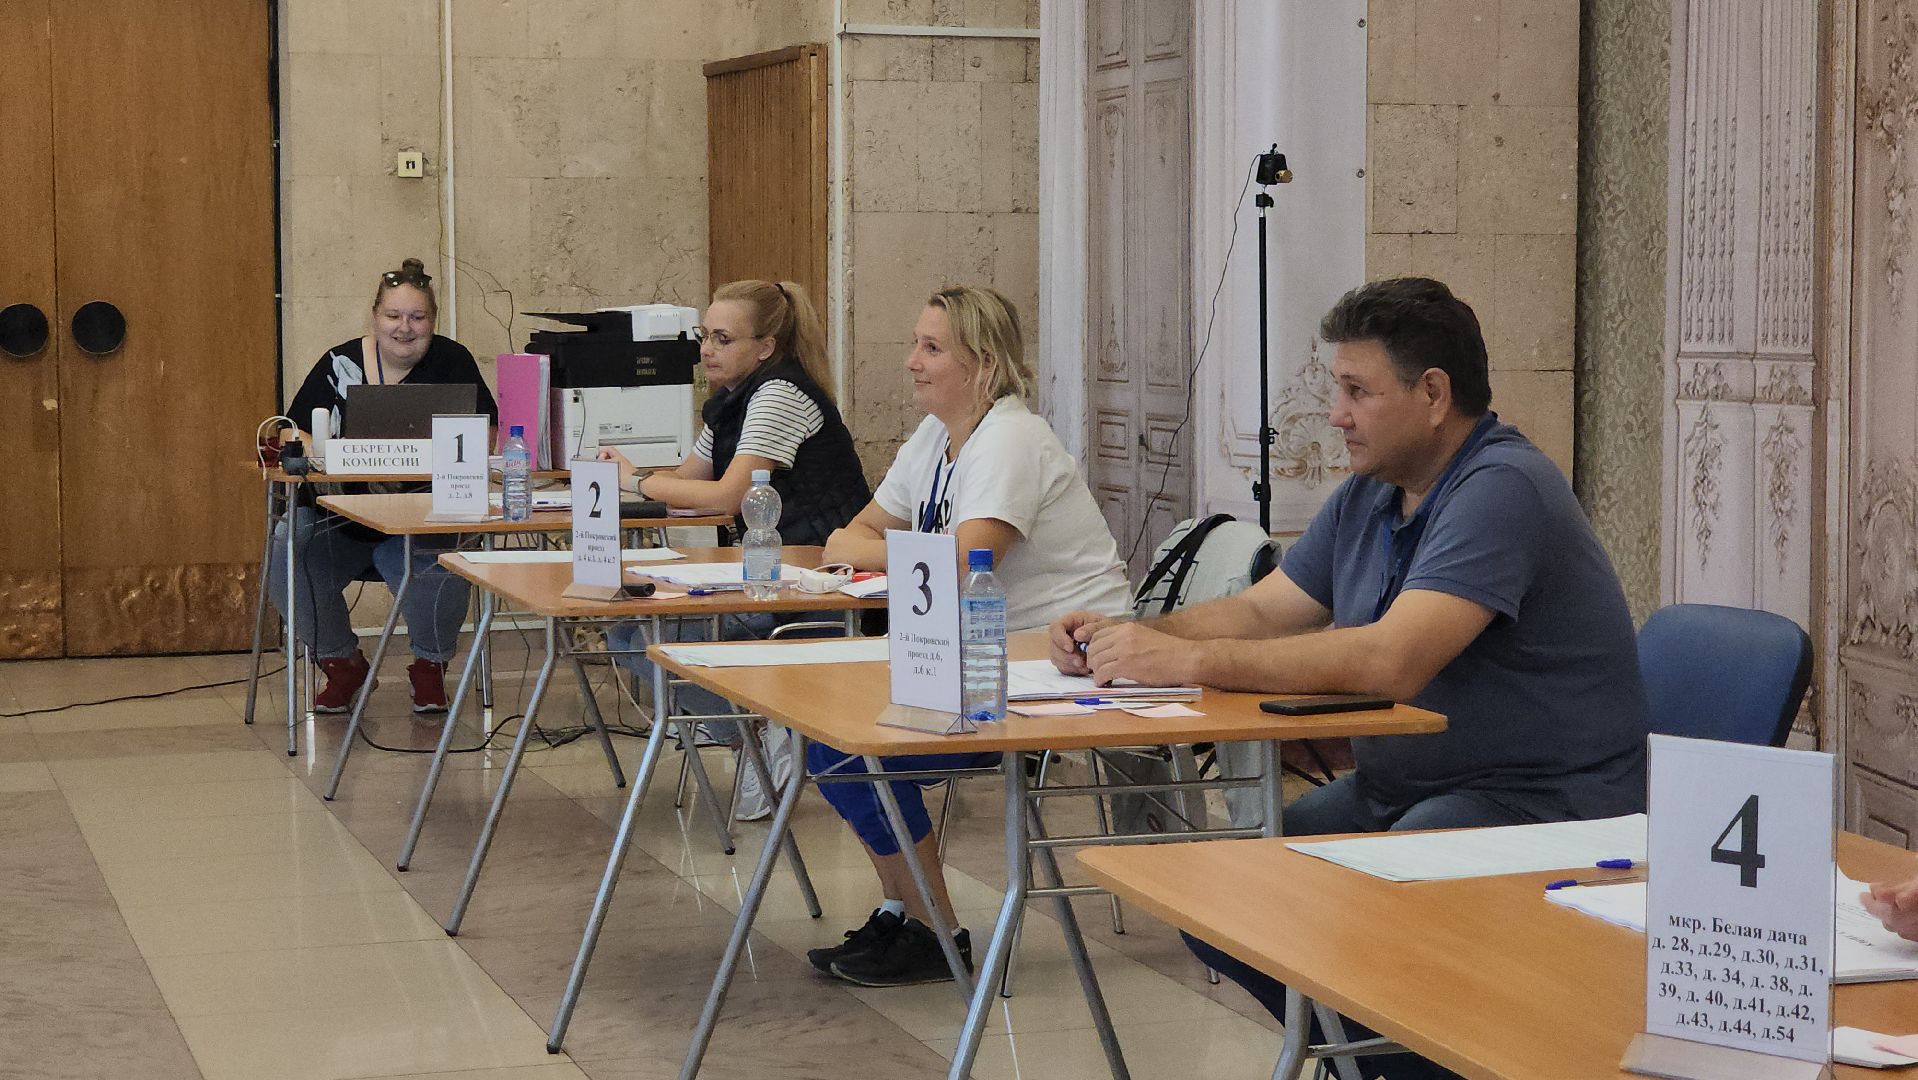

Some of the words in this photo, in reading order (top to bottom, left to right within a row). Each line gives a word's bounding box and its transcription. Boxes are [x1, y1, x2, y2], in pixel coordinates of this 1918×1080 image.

[342, 444, 419, 454] СЕКРЕТАРЬ
[342, 457, 420, 467] КОМИССИИ
[454, 433, 468, 463] 1
[587, 481, 603, 518] 2
[912, 561, 933, 616] 3
[1711, 794, 1766, 888] 4
[1669, 914, 1706, 934] мкр.
[1711, 917, 1763, 940] Белая
[1766, 929, 1808, 946] дача
[1651, 936, 1666, 950] д.
[1671, 936, 1694, 955] 28,
[1698, 942, 1736, 962] д.29,
[1740, 949, 1779, 969] д.30,
[1783, 955, 1824, 975] д.31,
[1660, 961, 1698, 980] д.33,
[1702, 969, 1717, 982] д.
[1721, 968, 1746, 988] 34,
[1750, 976, 1765, 989] д.
[1769, 975, 1794, 996] 38,
[1798, 984, 1813, 997] д.
[1658, 983, 1682, 1001] 39,
[1686, 990, 1700, 1003] д.
[1704, 990, 1729, 1009] 40,
[1732, 997, 1771, 1017] д.41,
[1775, 1004, 1815, 1025] д.42,
[1675, 1011, 1714, 1032] д.43,
[1718, 1019, 1757, 1040] д.44,
[1761, 1026, 1795, 1043] д.54
